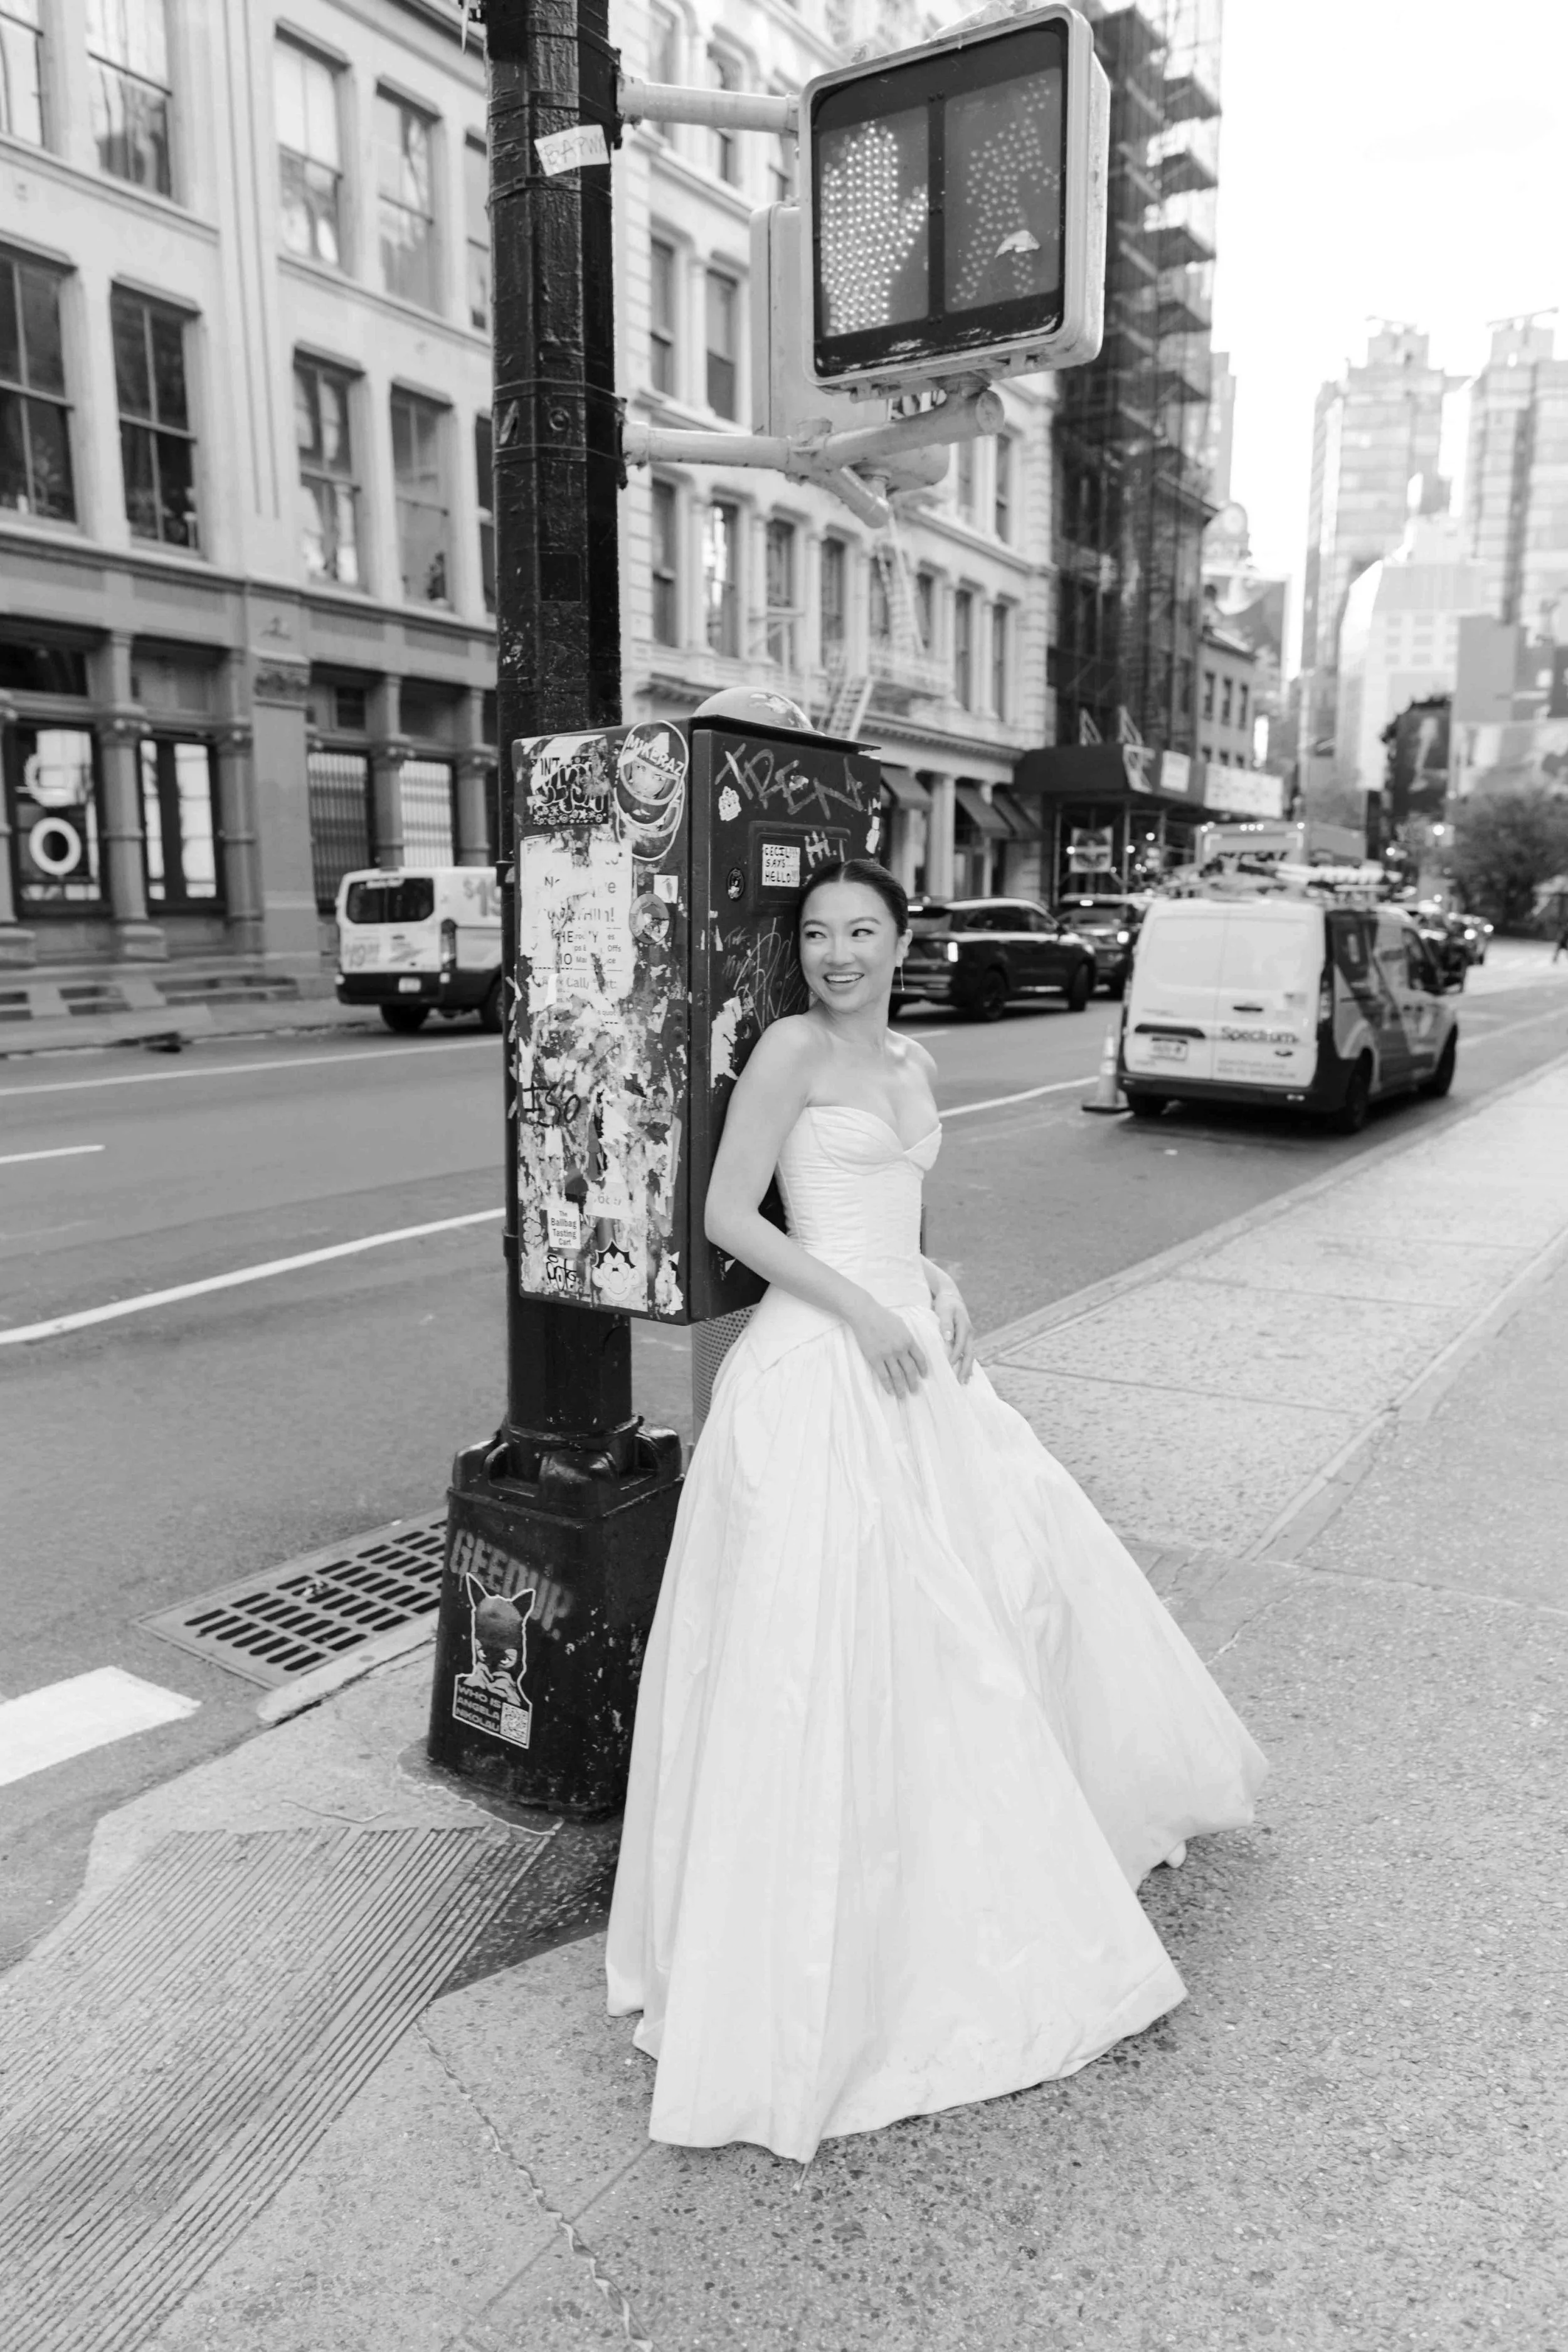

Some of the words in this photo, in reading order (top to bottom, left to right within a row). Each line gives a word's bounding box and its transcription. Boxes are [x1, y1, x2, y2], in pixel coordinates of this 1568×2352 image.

[552, 1228, 577, 1239] Tasting
[457, 1684, 488, 1703] WHO
[489, 1698, 501, 1709] IS
[457, 1697, 500, 1720] ANGELA
[456, 1707, 500, 1732] NIKOLAU
